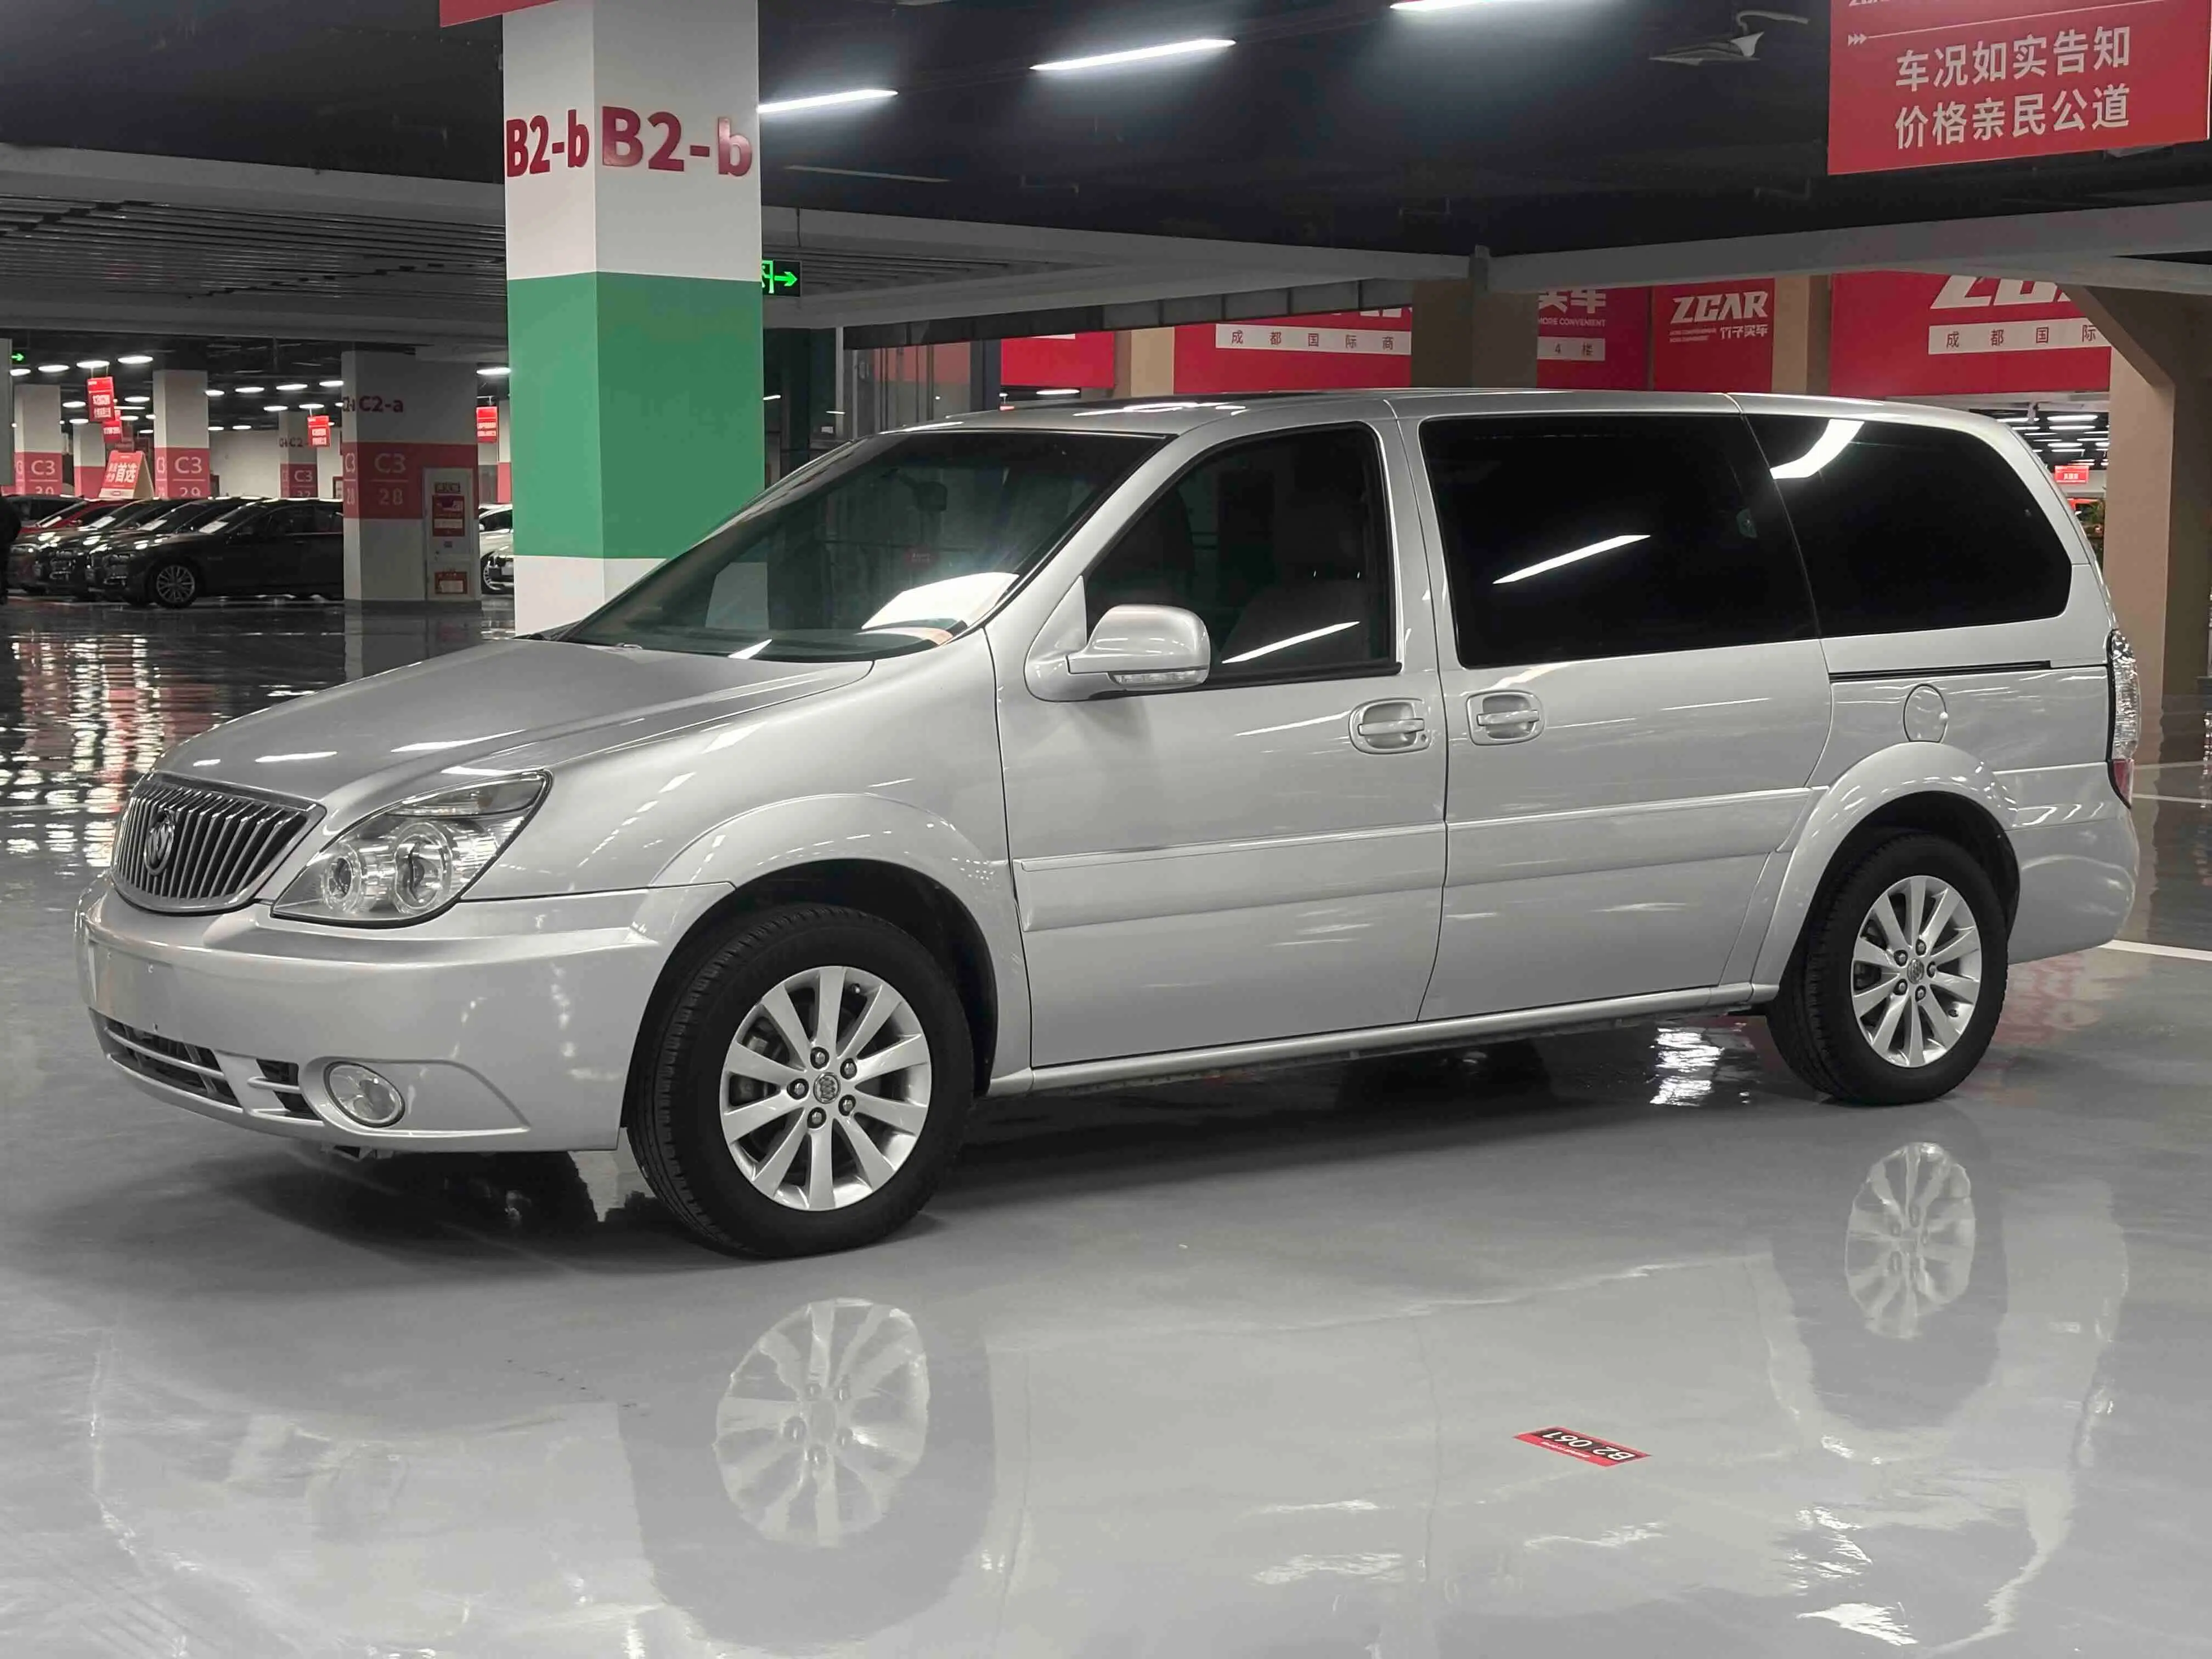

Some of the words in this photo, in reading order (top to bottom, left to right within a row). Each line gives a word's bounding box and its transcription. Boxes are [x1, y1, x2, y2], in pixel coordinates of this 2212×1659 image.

[1895, 26, 2131, 92] 车况如实告知
[1895, 83, 2130, 149] 价格亲民公道
[506, 110, 590, 177] B2-b
[602, 106, 753, 177] B2-b
[1671, 291, 1768, 324] ZCAR
[1232, 330, 1394, 350] 成都国际商
[1720, 324, 1768, 340] 竹子买车
[1946, 324, 2096, 348] 成都国际
[359, 395, 404, 413] C2-a
[30, 460, 55, 476] C3
[174, 456, 202, 474] C3
[374, 453, 406, 474] C3
[294, 470, 313, 482] C3
[1542, 1431, 1593, 1448] 061
[1593, 1446, 1635, 1460] B2
